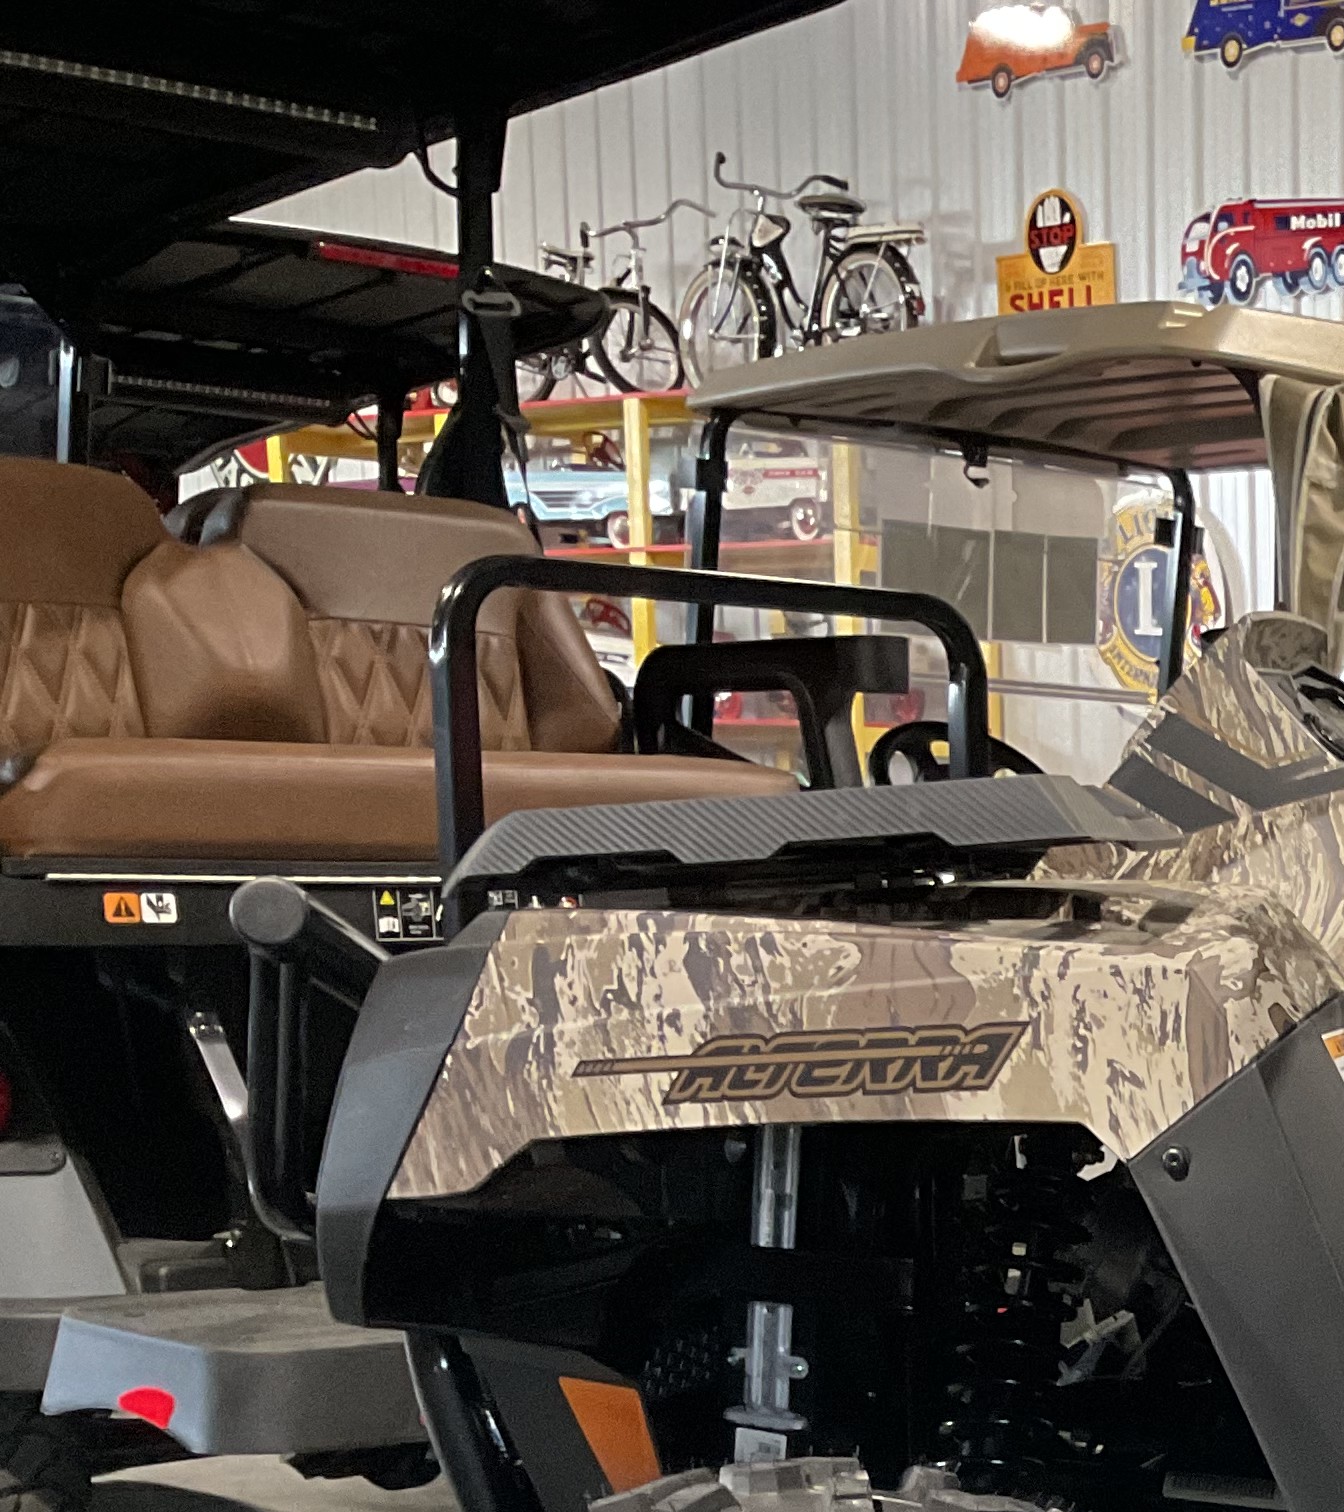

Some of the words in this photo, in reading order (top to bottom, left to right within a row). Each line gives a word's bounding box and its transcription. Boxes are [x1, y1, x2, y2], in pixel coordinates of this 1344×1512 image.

[1290, 212, 1341, 231] Mobil
[1030, 223, 1075, 250] STOP
[1078, 271, 1104, 281] WITH
